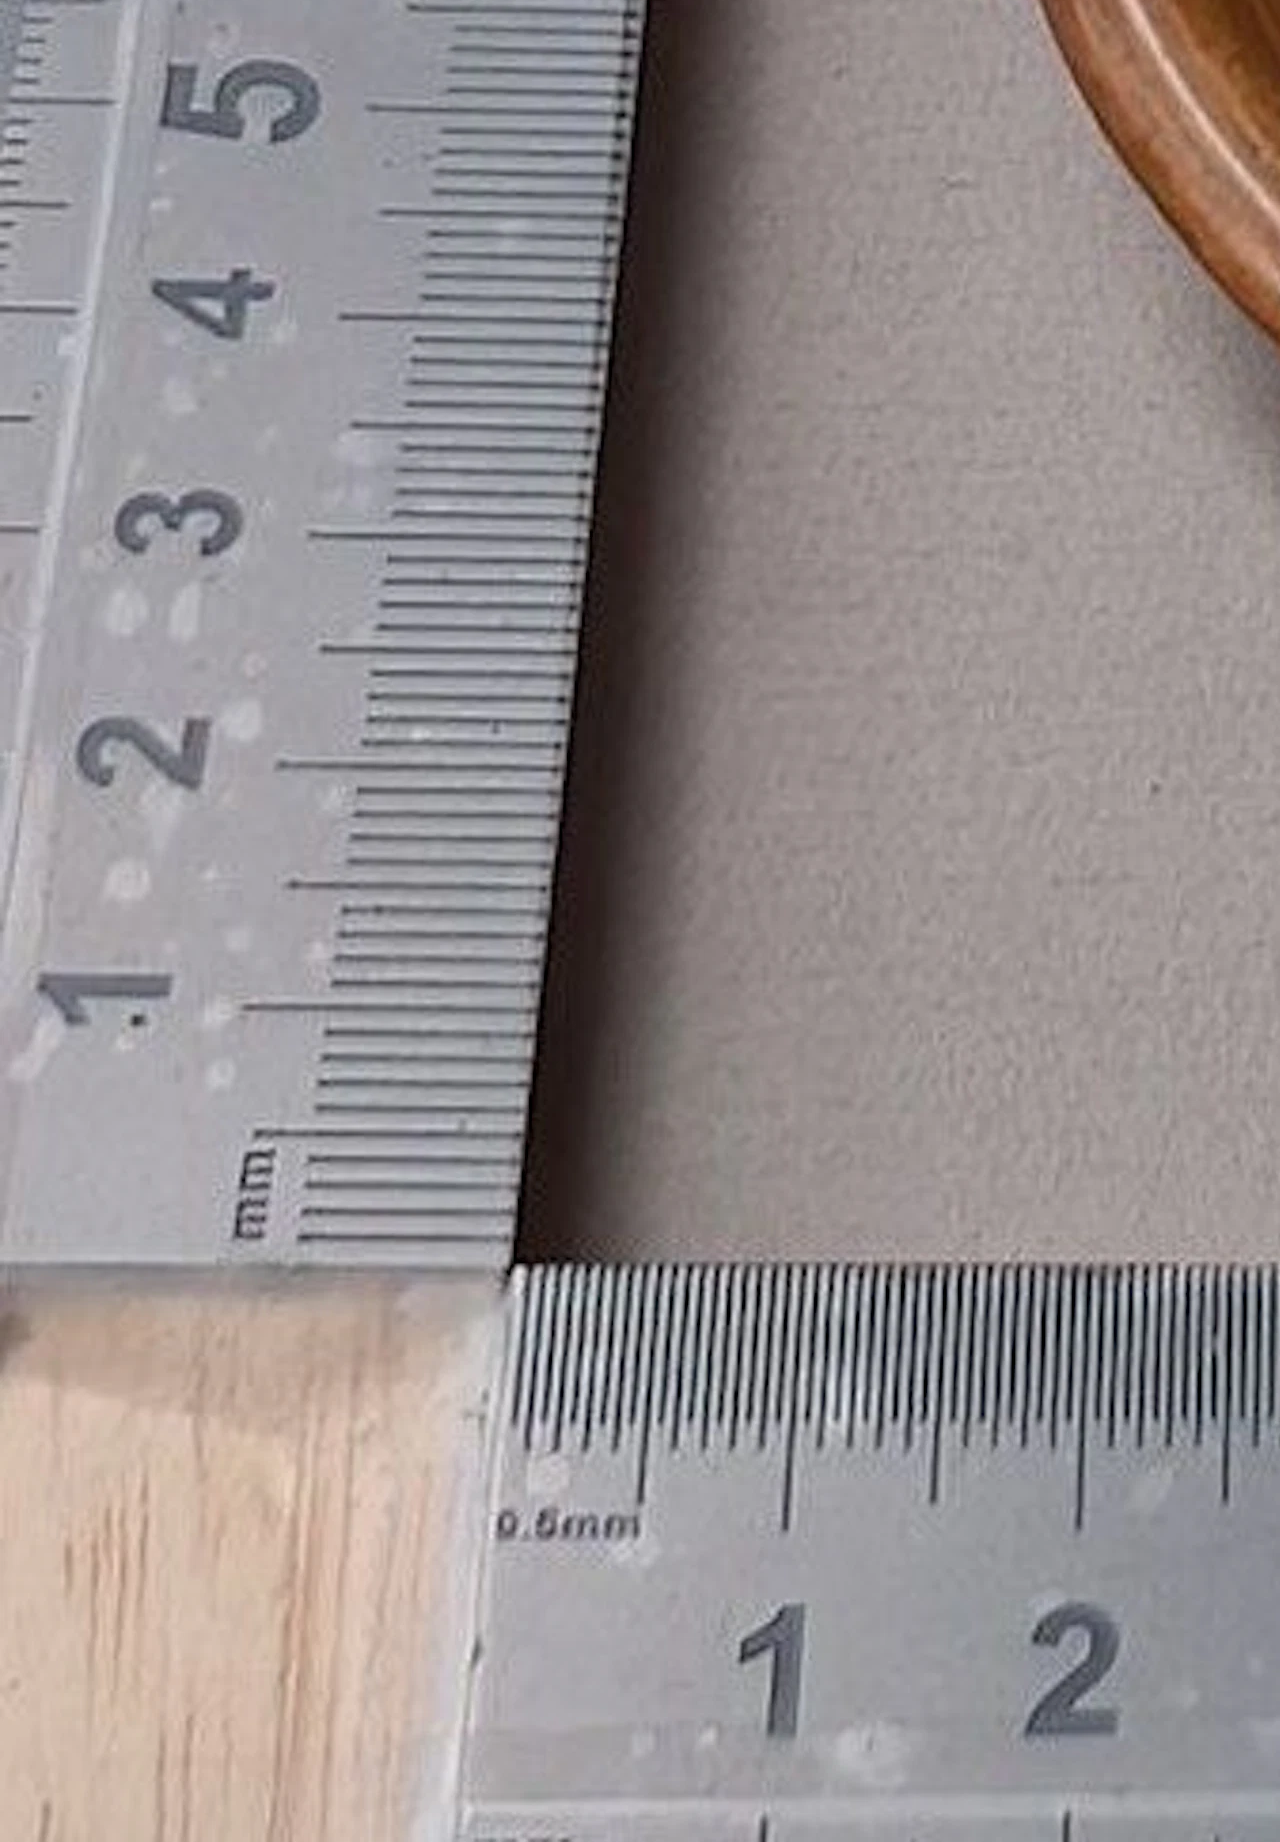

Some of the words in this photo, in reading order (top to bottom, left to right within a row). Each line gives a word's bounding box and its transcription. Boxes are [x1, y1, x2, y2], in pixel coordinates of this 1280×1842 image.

[159, 60, 320, 144] 5
[151, 269, 274, 340] 4
[114, 490, 243, 558] 3
[76, 717, 211, 791] 2
[37, 973, 171, 1026] 1
[233, 1149, 277, 1240] mm
[738, 1604, 804, 1737] 1
[1023, 1602, 1119, 1738] 2
